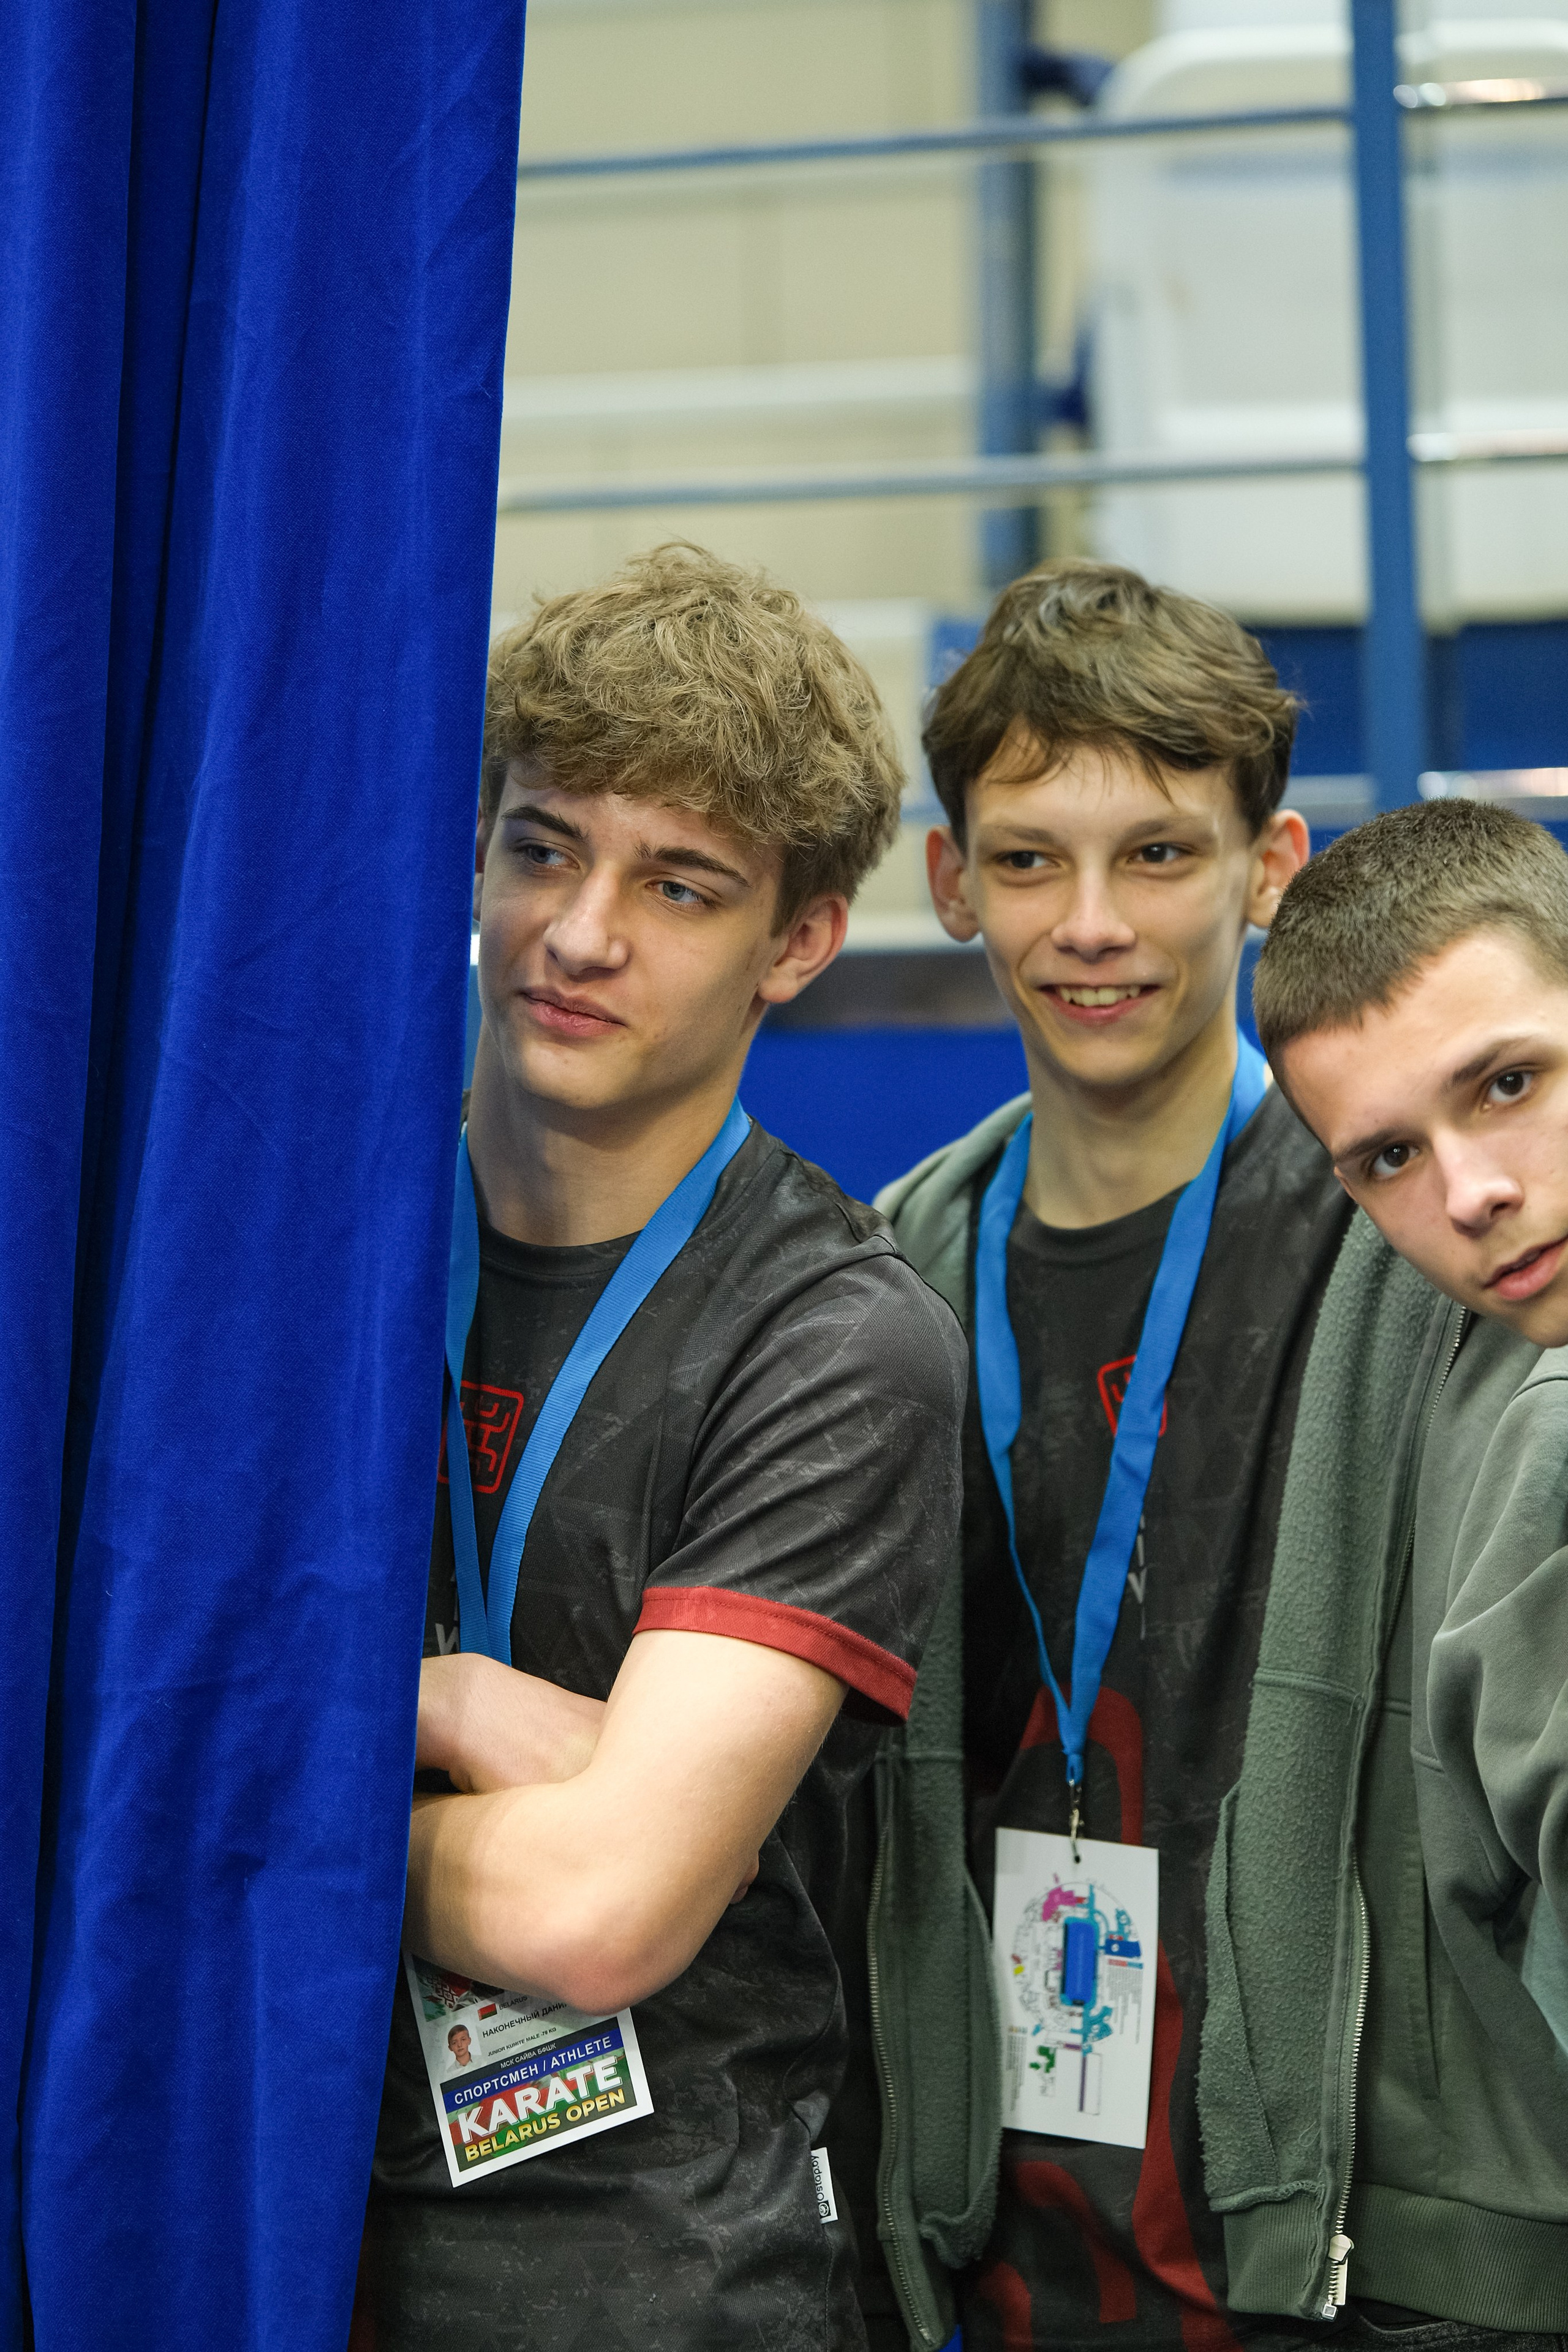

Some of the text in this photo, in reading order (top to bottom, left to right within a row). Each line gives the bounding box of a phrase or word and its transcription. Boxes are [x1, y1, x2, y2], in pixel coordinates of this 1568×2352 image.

[482, 2002, 567, 2038] НАКОНЕЧНЫЙ ДАНИ
[499, 1996, 528, 2010] BELARUS
[488, 2046, 505, 2057] JUNIOR
[506, 2039, 525, 2050] KUMITE
[526, 2034, 540, 2042] MALE
[500, 2043, 557, 2068] МСК САЙВА БФШК
[454, 2064, 539, 2105] СПОРТСМЕН
[551, 2036, 612, 2069] ATHLETE
[458, 2055, 623, 2144] KARATE
[464, 2088, 625, 2162] BELARUS OPEN
